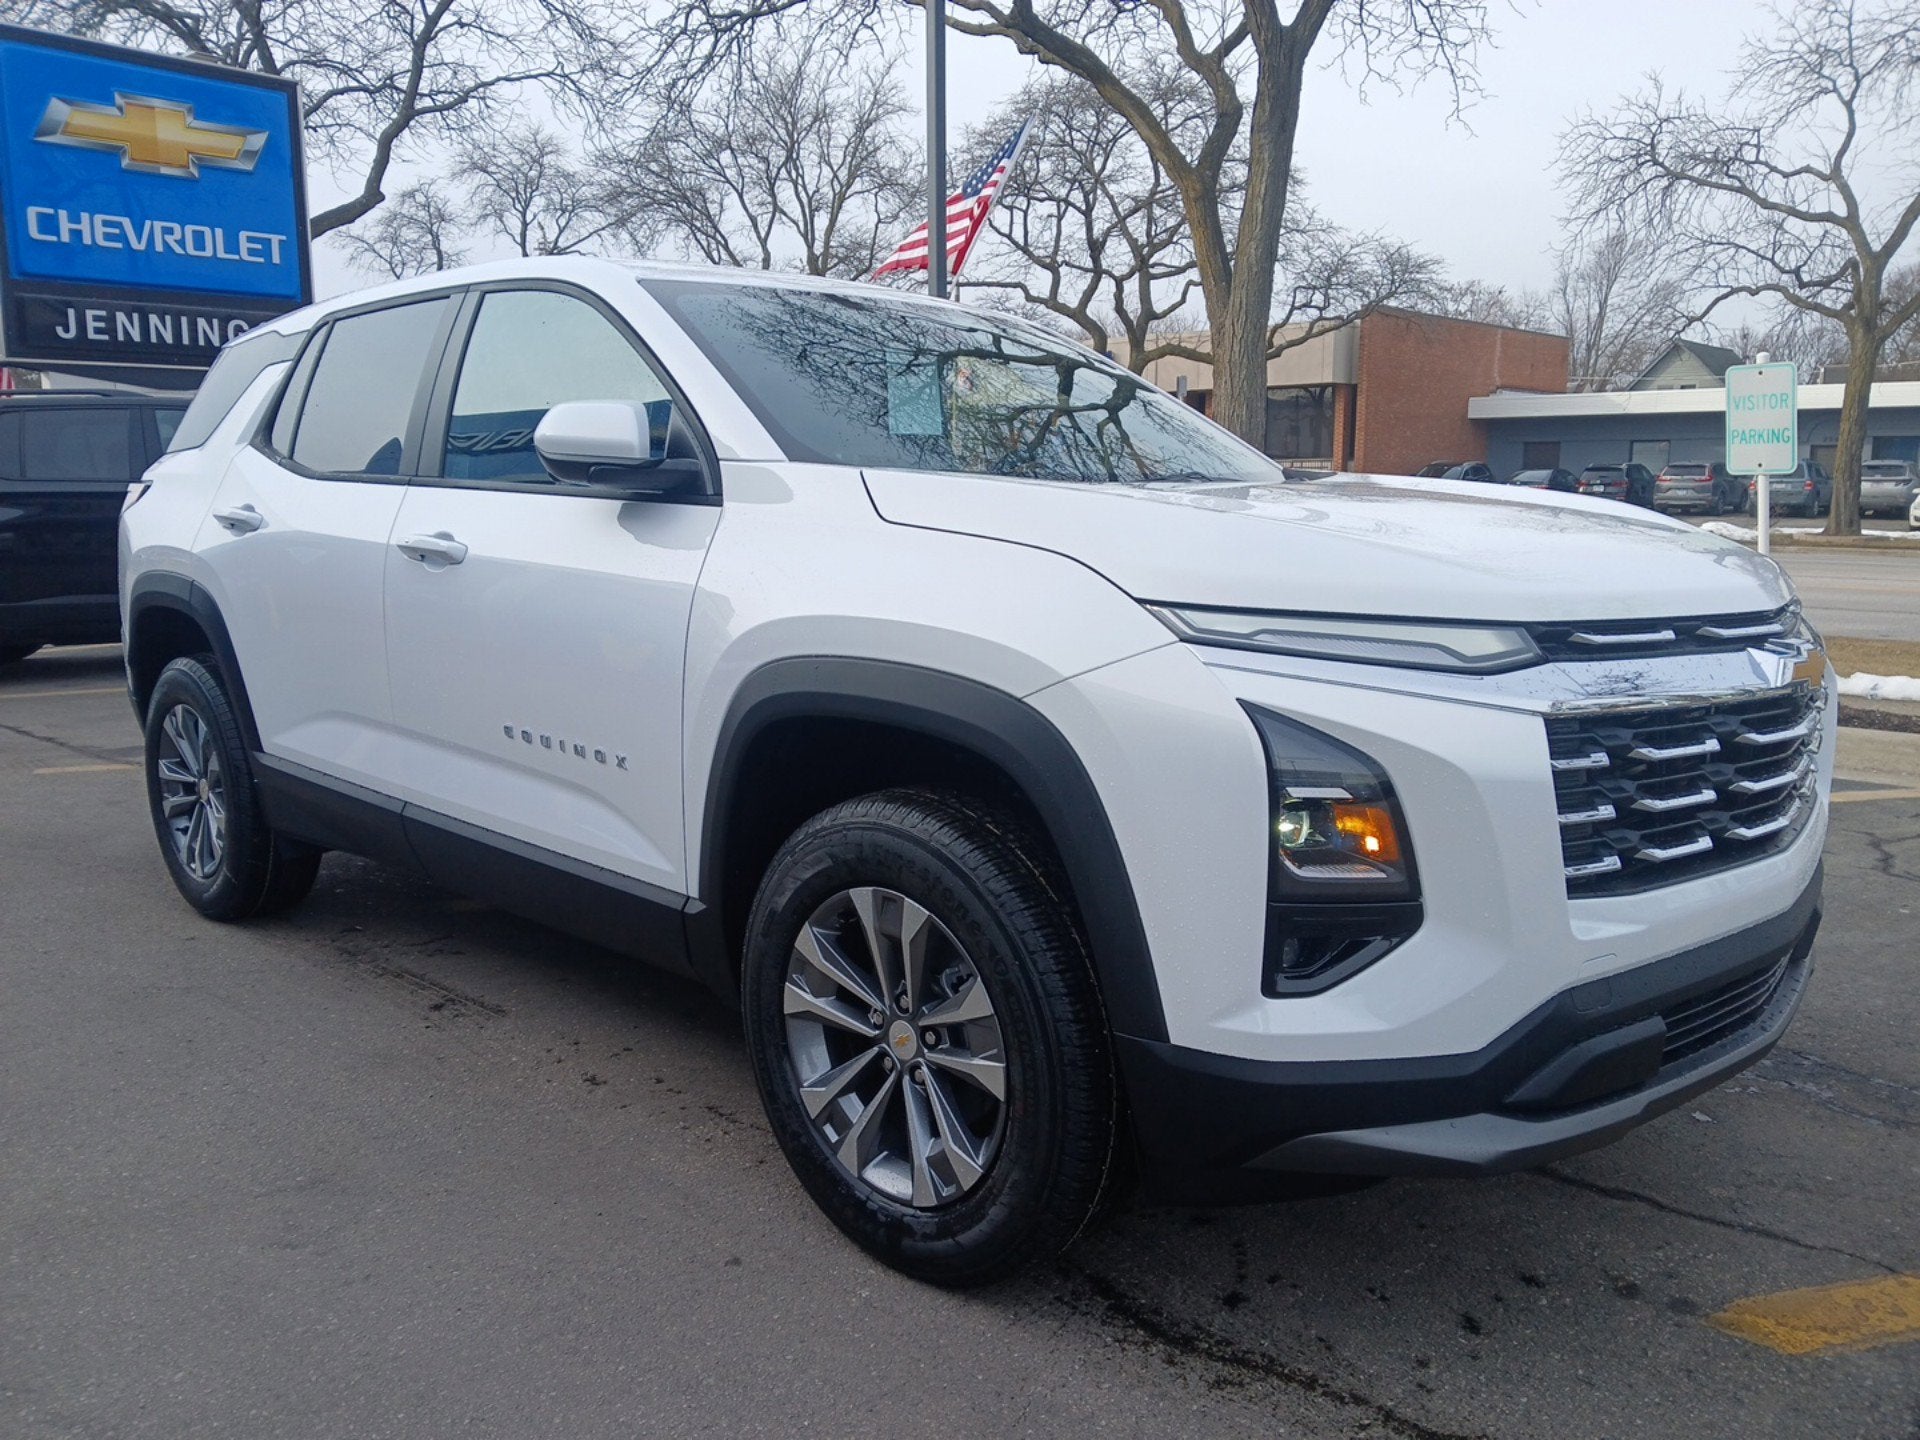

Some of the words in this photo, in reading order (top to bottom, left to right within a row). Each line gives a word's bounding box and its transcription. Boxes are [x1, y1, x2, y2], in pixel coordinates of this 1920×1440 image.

[26, 206, 287, 264] CHEVROLET
[1732, 393, 1789, 411] VISITOR
[1731, 427, 1791, 445] PARKING
[503, 724, 628, 771] EQUINOX
